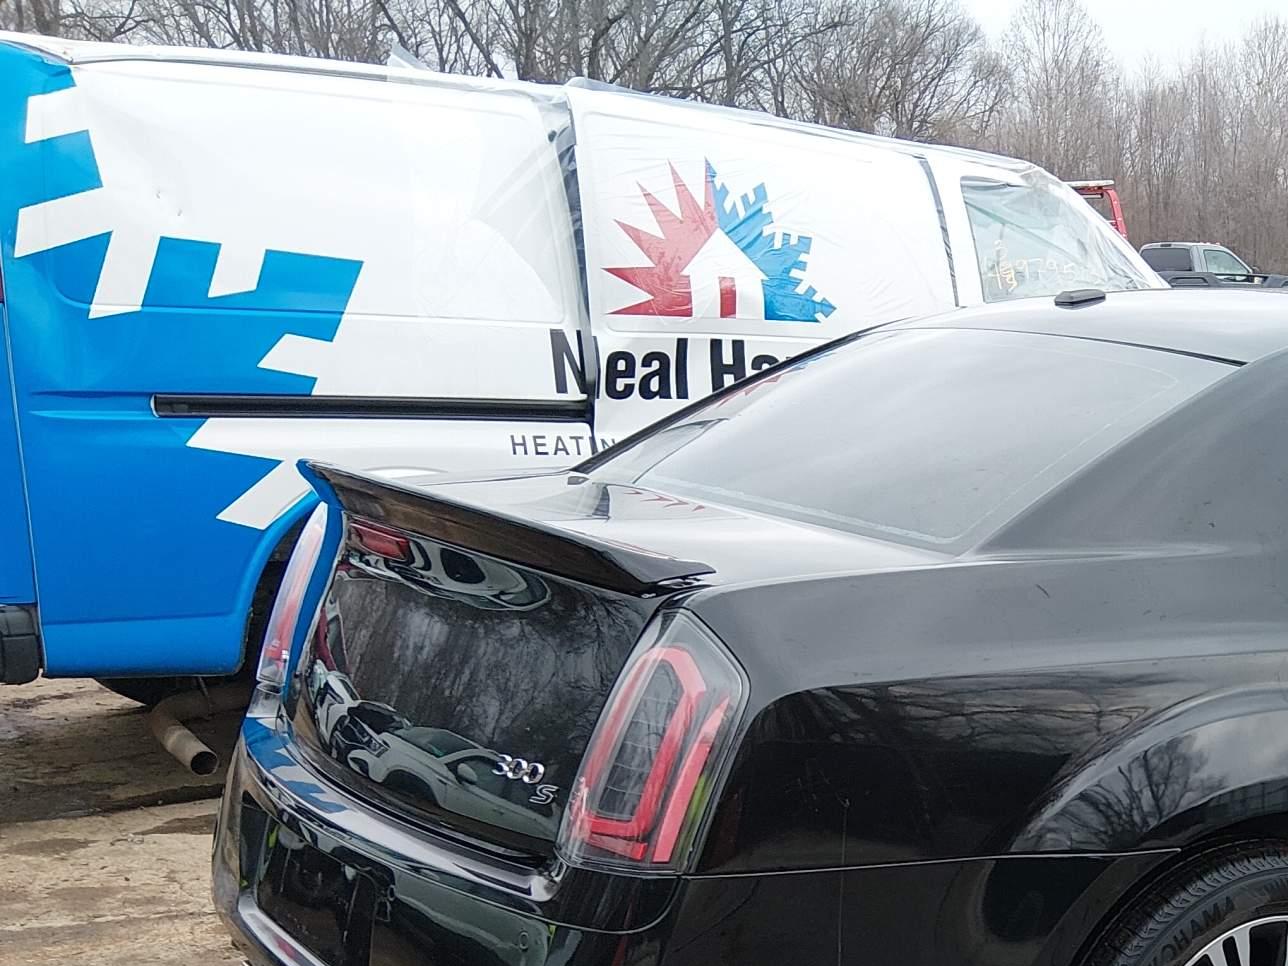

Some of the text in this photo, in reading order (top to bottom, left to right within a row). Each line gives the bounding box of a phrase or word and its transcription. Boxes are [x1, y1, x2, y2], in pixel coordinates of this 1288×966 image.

[549, 328, 689, 400] Neal
[491, 754, 545, 784] 300
[528, 784, 560, 805] S
